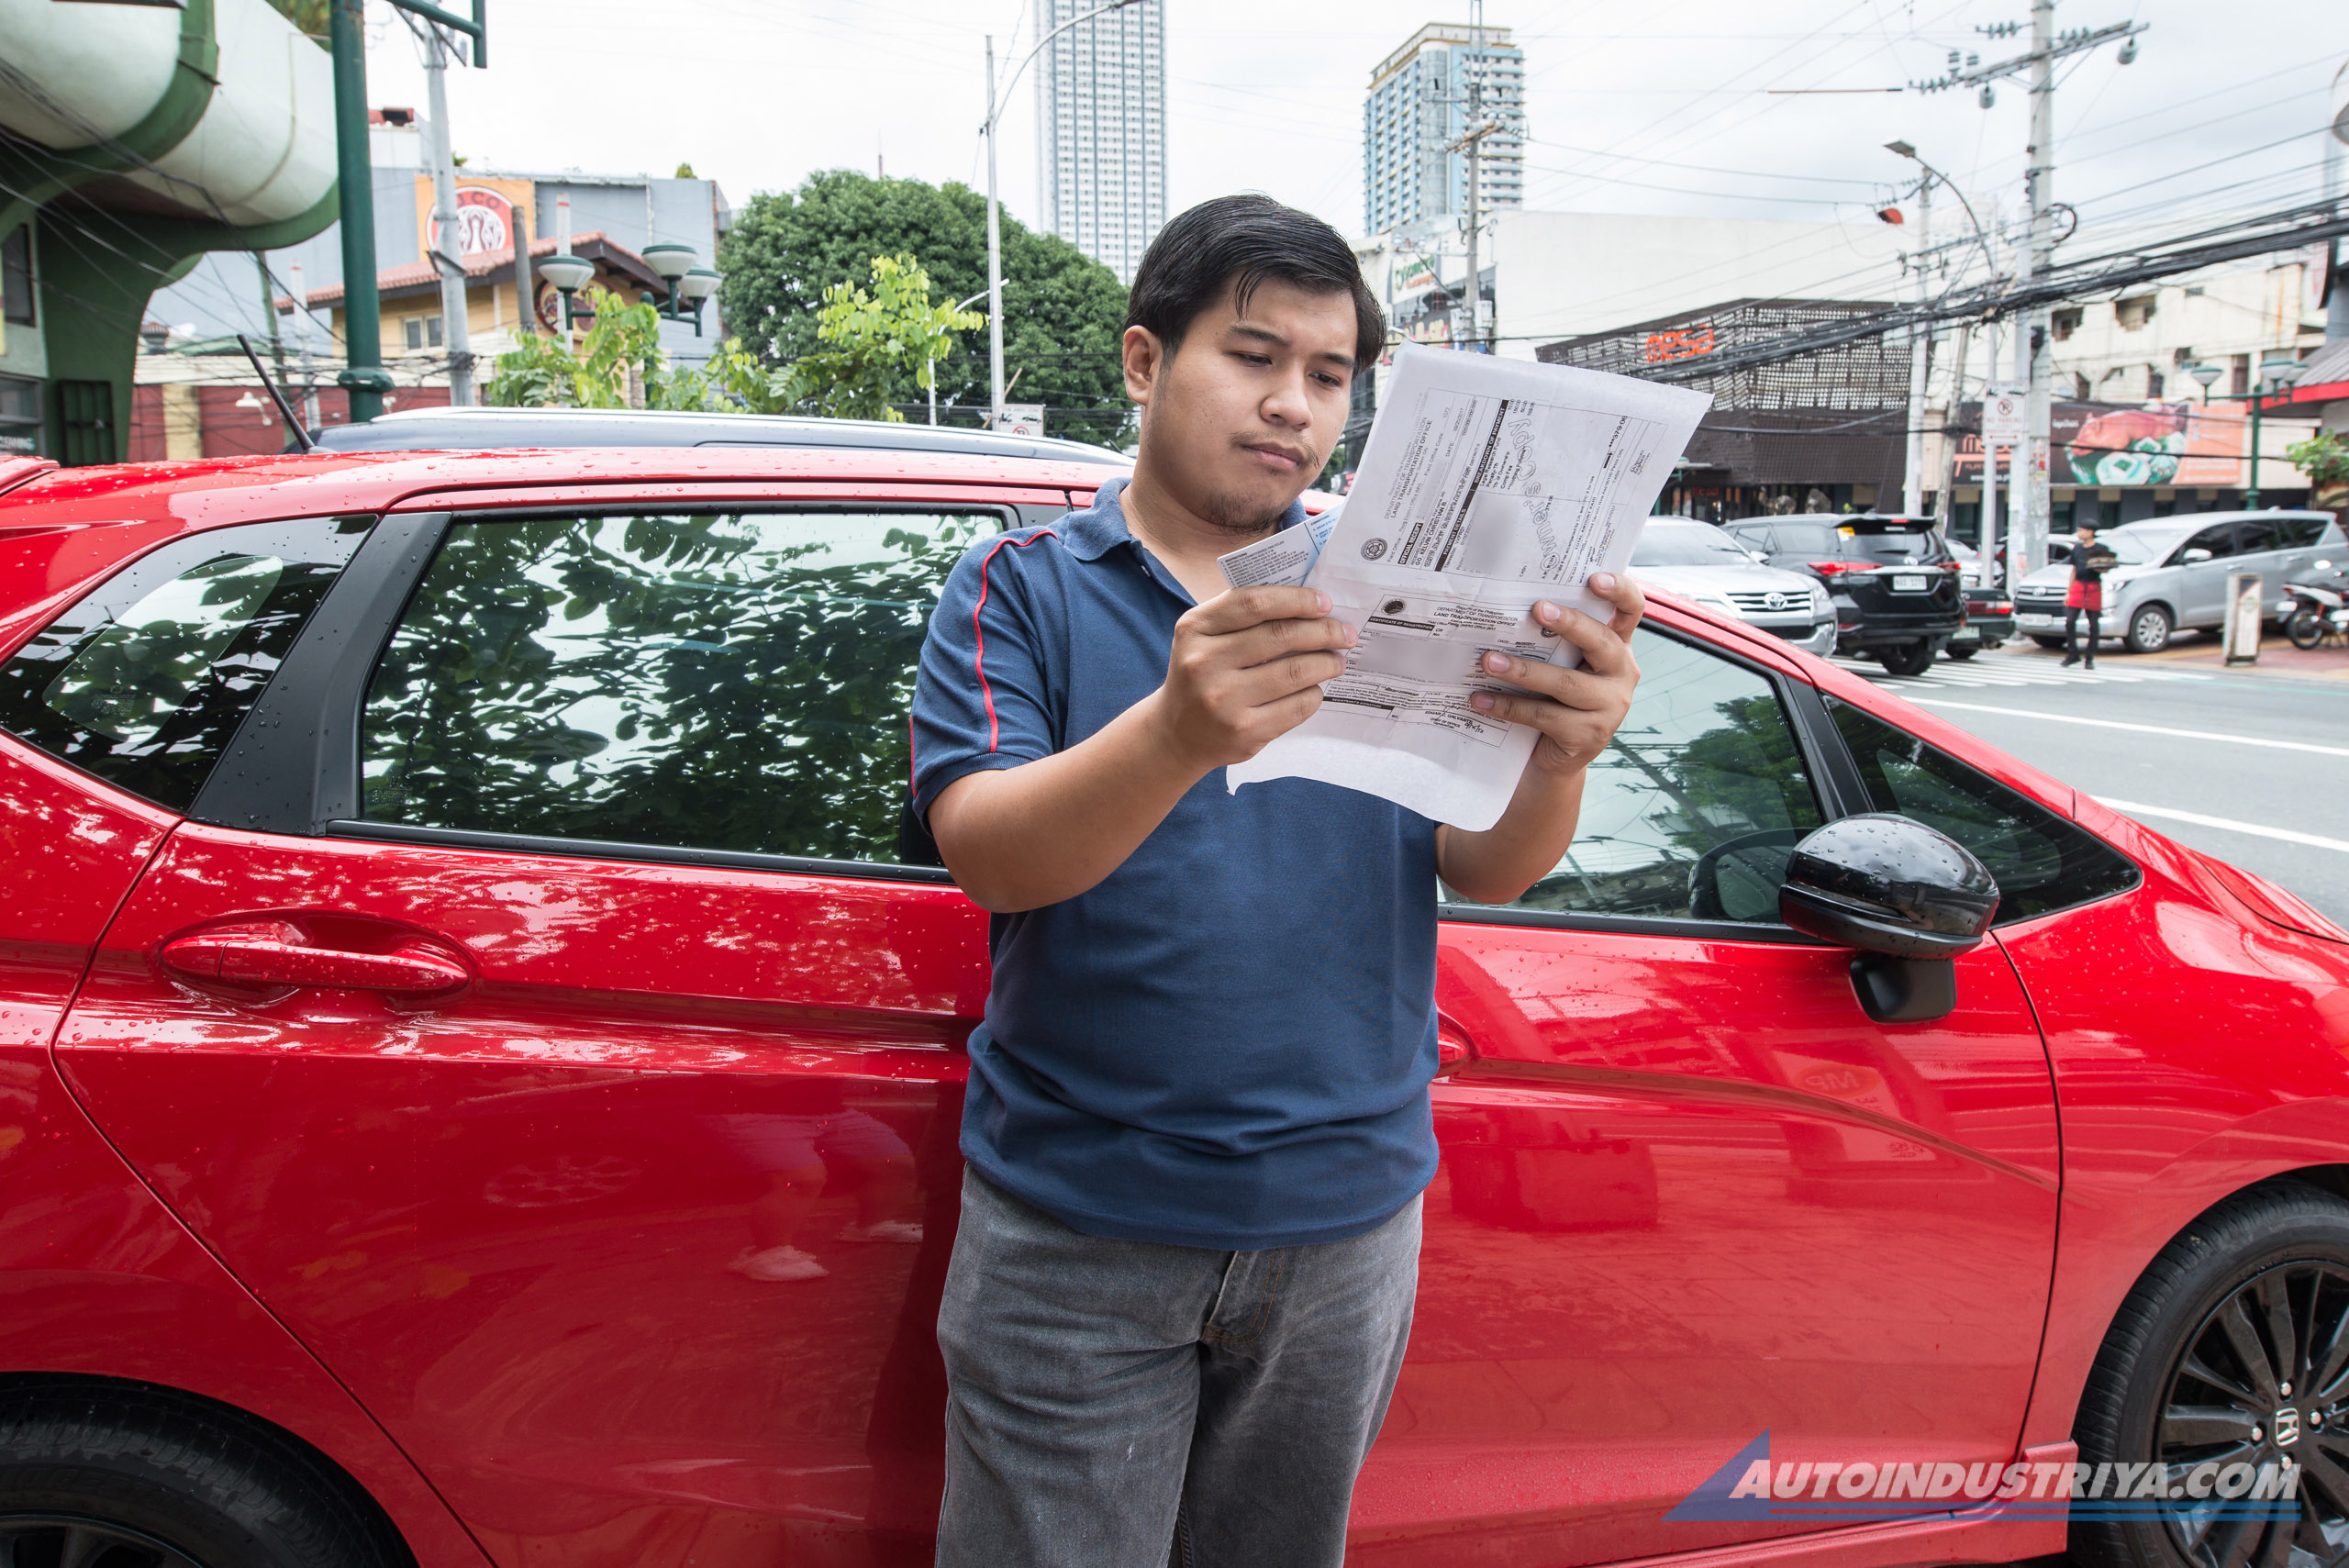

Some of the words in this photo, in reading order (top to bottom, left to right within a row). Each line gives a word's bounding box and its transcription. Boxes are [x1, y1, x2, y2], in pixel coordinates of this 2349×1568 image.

[1384, 482, 1402, 519] DEPARTMENT
[1399, 473, 1406, 481] OF
[1403, 417, 1427, 471] TRANSPORTATION
[1473, 445, 1493, 484] BREAKDOWN
[1488, 436, 1496, 444] OF
[1492, 407, 1506, 435] PAYMENT
[1484, 450, 1496, 473] Research
[1493, 437, 1501, 450] Fund
[1508, 418, 1536, 481] Copy
[1391, 502, 1401, 518] LAND
[1398, 445, 1423, 500] TRANSPORTATION
[1419, 421, 1432, 444] OFFICE
[1399, 544, 1413, 564] OFFICIAL
[1408, 524, 1422, 543] RECEIPT
[1419, 537, 1431, 555] KELVIN
[1429, 507, 1444, 536] CHRISTIAN
[1442, 531, 1457, 555] PAYMENT
[1453, 508, 1467, 530] DETAILS
[1371, 617, 1397, 625] CERTIFICATE
[1403, 622, 1432, 630] REGISTRATION
[1451, 614, 1496, 624] TRANSPORTATION
[1477, 613, 1518, 621] TRANSPORTATION
